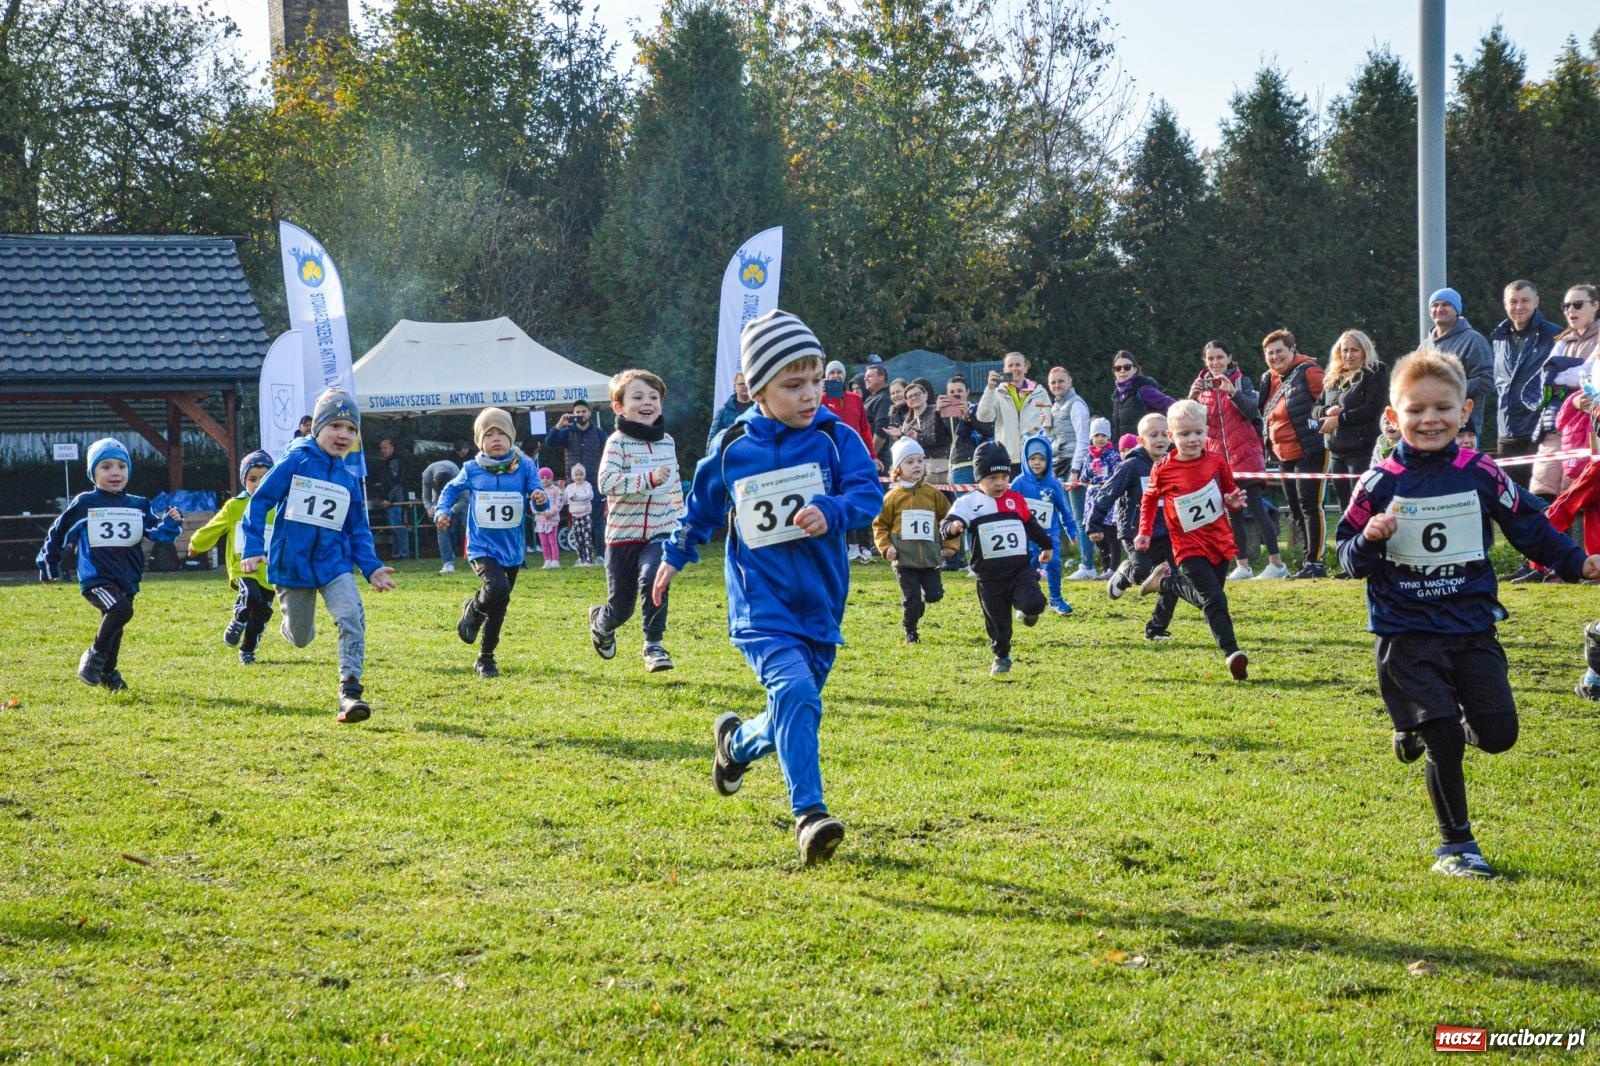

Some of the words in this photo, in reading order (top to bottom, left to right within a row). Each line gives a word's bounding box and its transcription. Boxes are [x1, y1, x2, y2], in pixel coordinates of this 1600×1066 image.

[369, 394, 442, 409] STOWARZYSZENIE
[449, 392, 485, 405] AKTYWNI
[492, 391, 508, 403] DLA
[516, 389, 556, 402] LEPSZEGO
[563, 387, 588, 400] JUTRA
[303, 495, 337, 520] 12
[486, 505, 514, 521] 19
[753, 493, 805, 532] 32
[1188, 497, 1216, 522] 21
[100, 522, 131, 539] 33
[910, 521, 930, 534] 16
[1421, 522, 1447, 553] 6
[991, 532, 1019, 552] 29
[1399, 581, 1421, 590] TYNKI
[1417, 585, 1458, 597] GAWLIK
